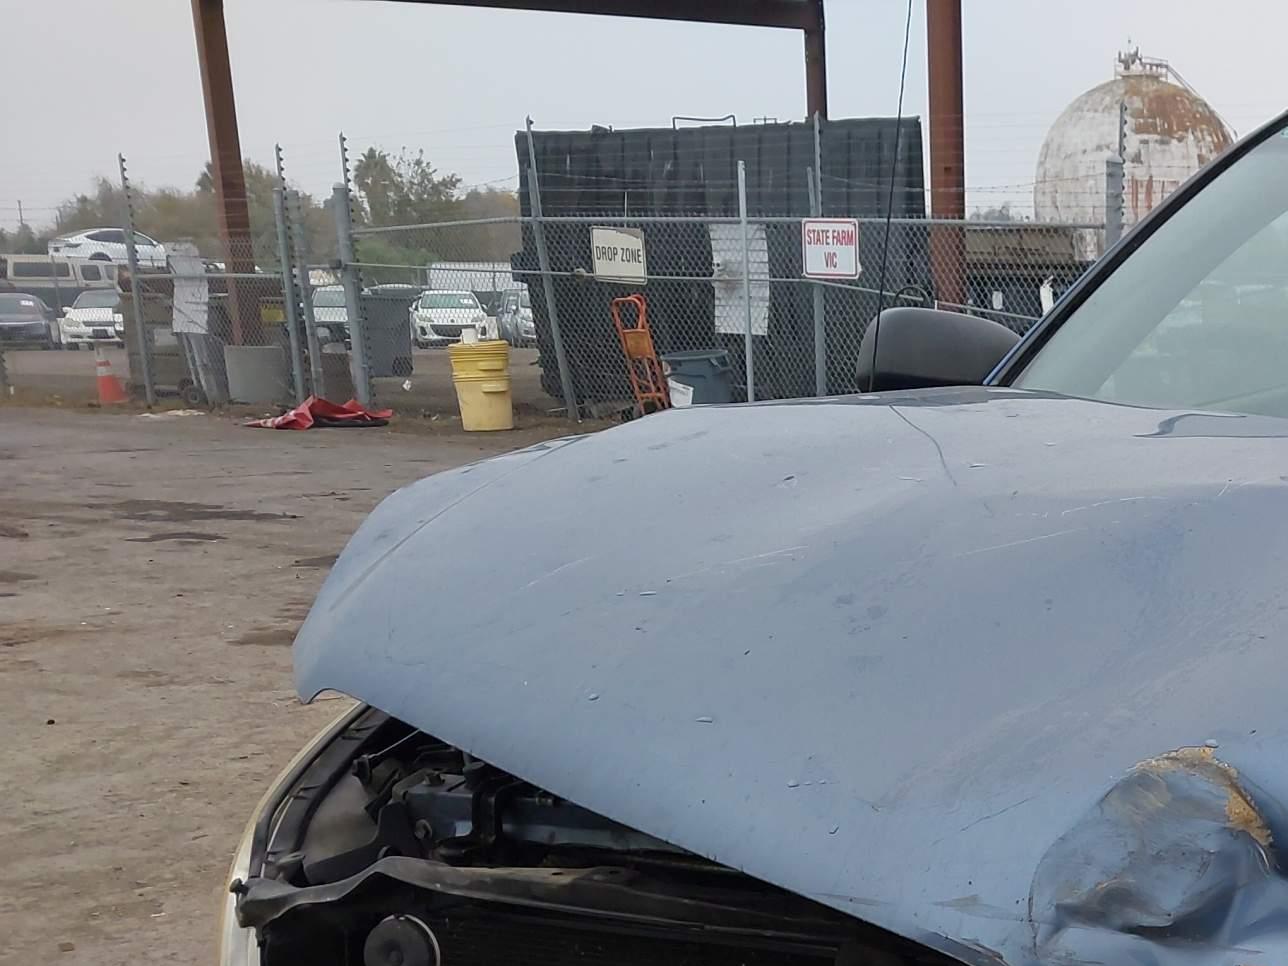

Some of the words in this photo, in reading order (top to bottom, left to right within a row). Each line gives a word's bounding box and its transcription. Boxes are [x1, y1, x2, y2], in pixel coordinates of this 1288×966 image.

[806, 229, 830, 246] STATE
[831, 229, 855, 246] FARM
[595, 245, 618, 262] DROP
[620, 247, 643, 264] ZONE
[823, 251, 838, 269] VIC
